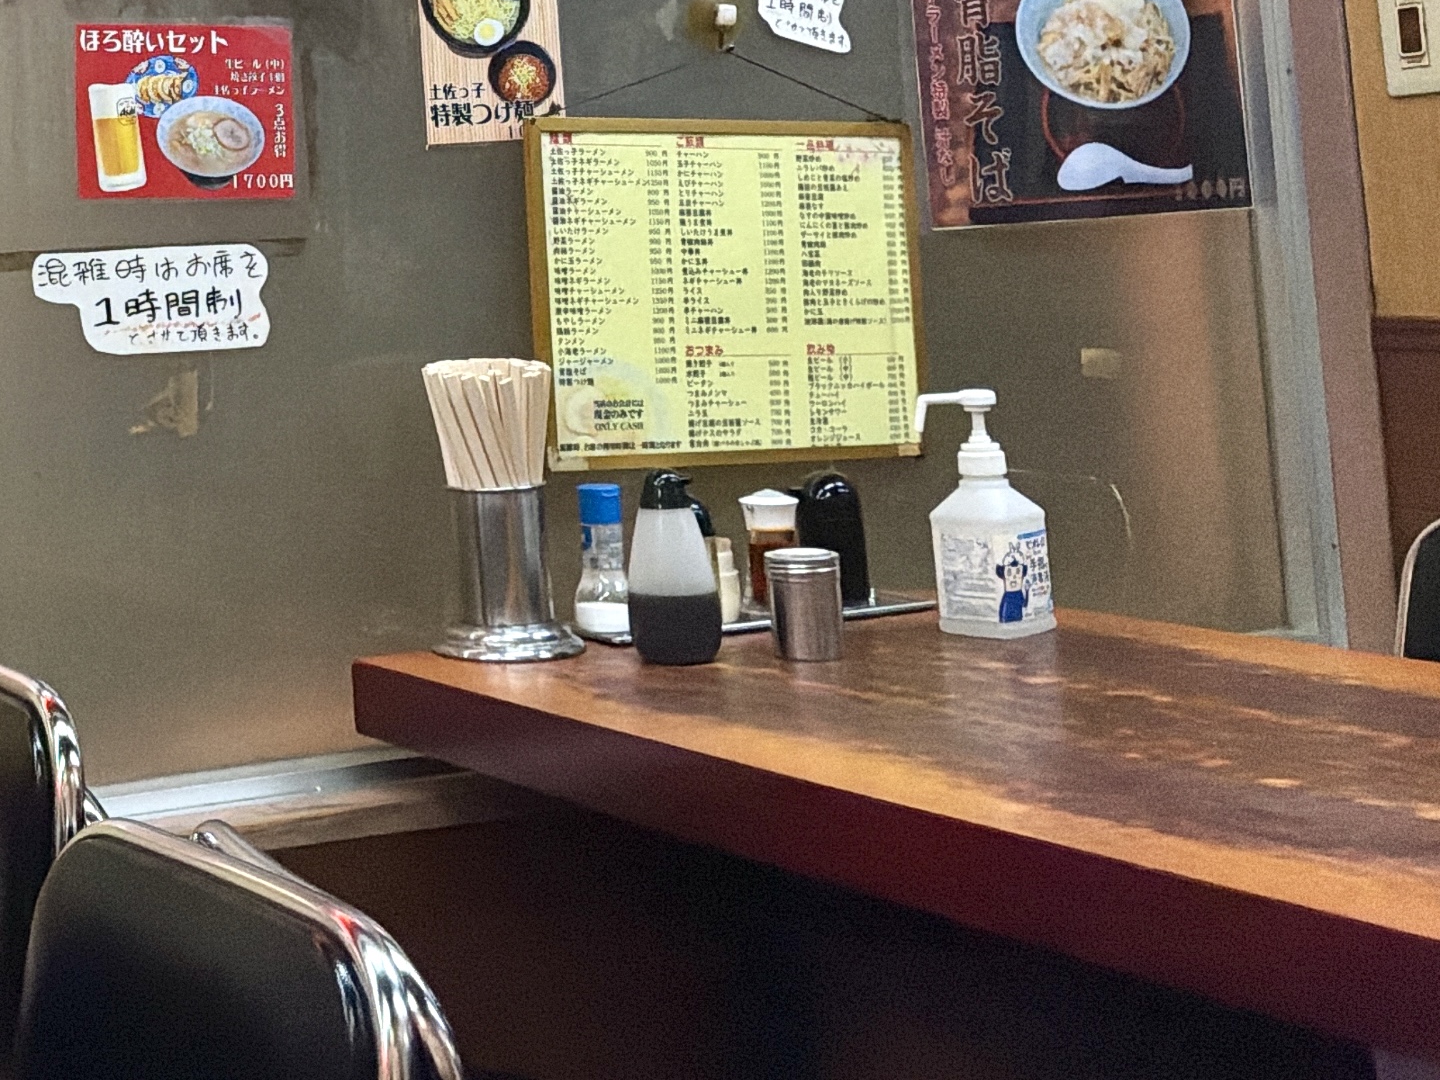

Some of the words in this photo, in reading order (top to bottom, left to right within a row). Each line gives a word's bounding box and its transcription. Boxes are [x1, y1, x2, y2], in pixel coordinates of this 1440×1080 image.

[80, 29, 229, 54] ほろ酔いセット
[430, 83, 485, 101] 土佐っ子
[431, 101, 534, 127] 特製つけ麺
[38, 250, 262, 287] 混雑時はお席を
[94, 287, 242, 327] 1時間制
[594, 422, 617, 432] ONLY
[620, 422, 644, 430] CASH
